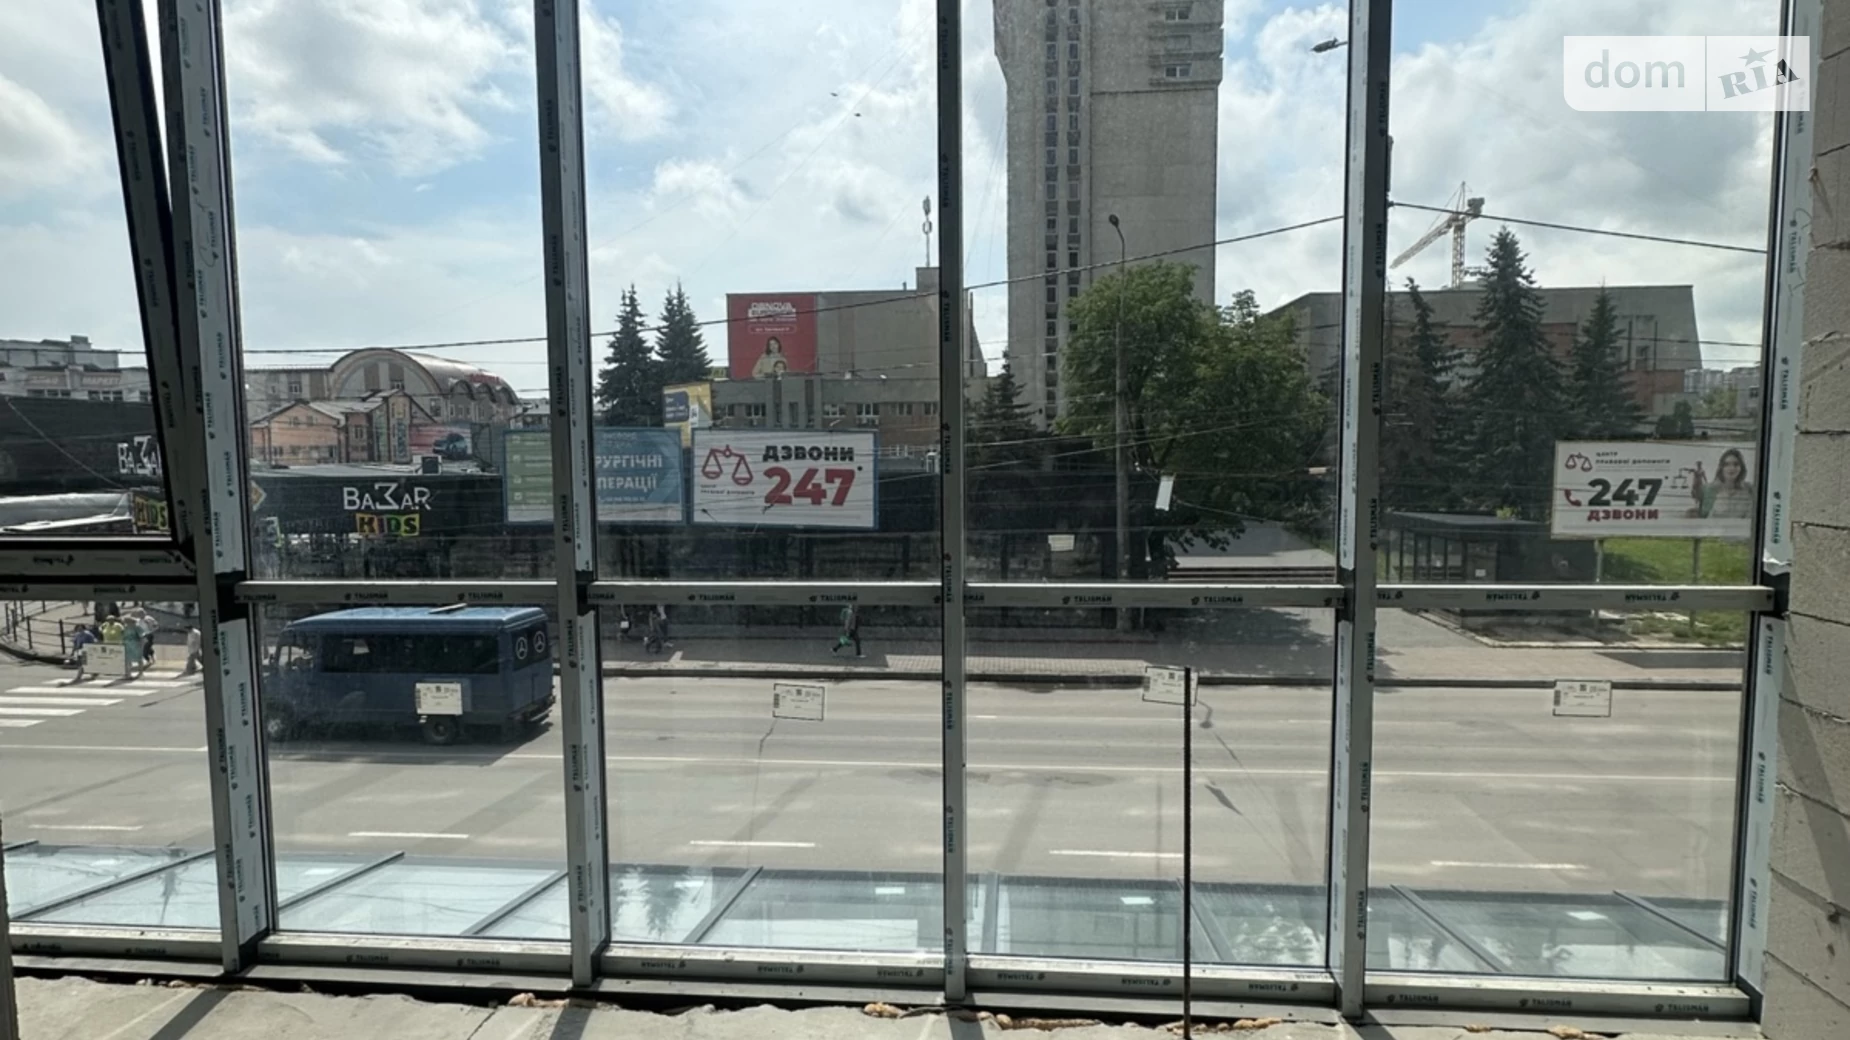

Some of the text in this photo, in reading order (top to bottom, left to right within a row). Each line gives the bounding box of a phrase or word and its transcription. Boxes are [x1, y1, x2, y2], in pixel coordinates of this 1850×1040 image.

[762, 444, 855, 462] ДЗВОНИ
[356, 514, 419, 535] KIDS
[1586, 508, 1660, 523] ДЗВОНИ
